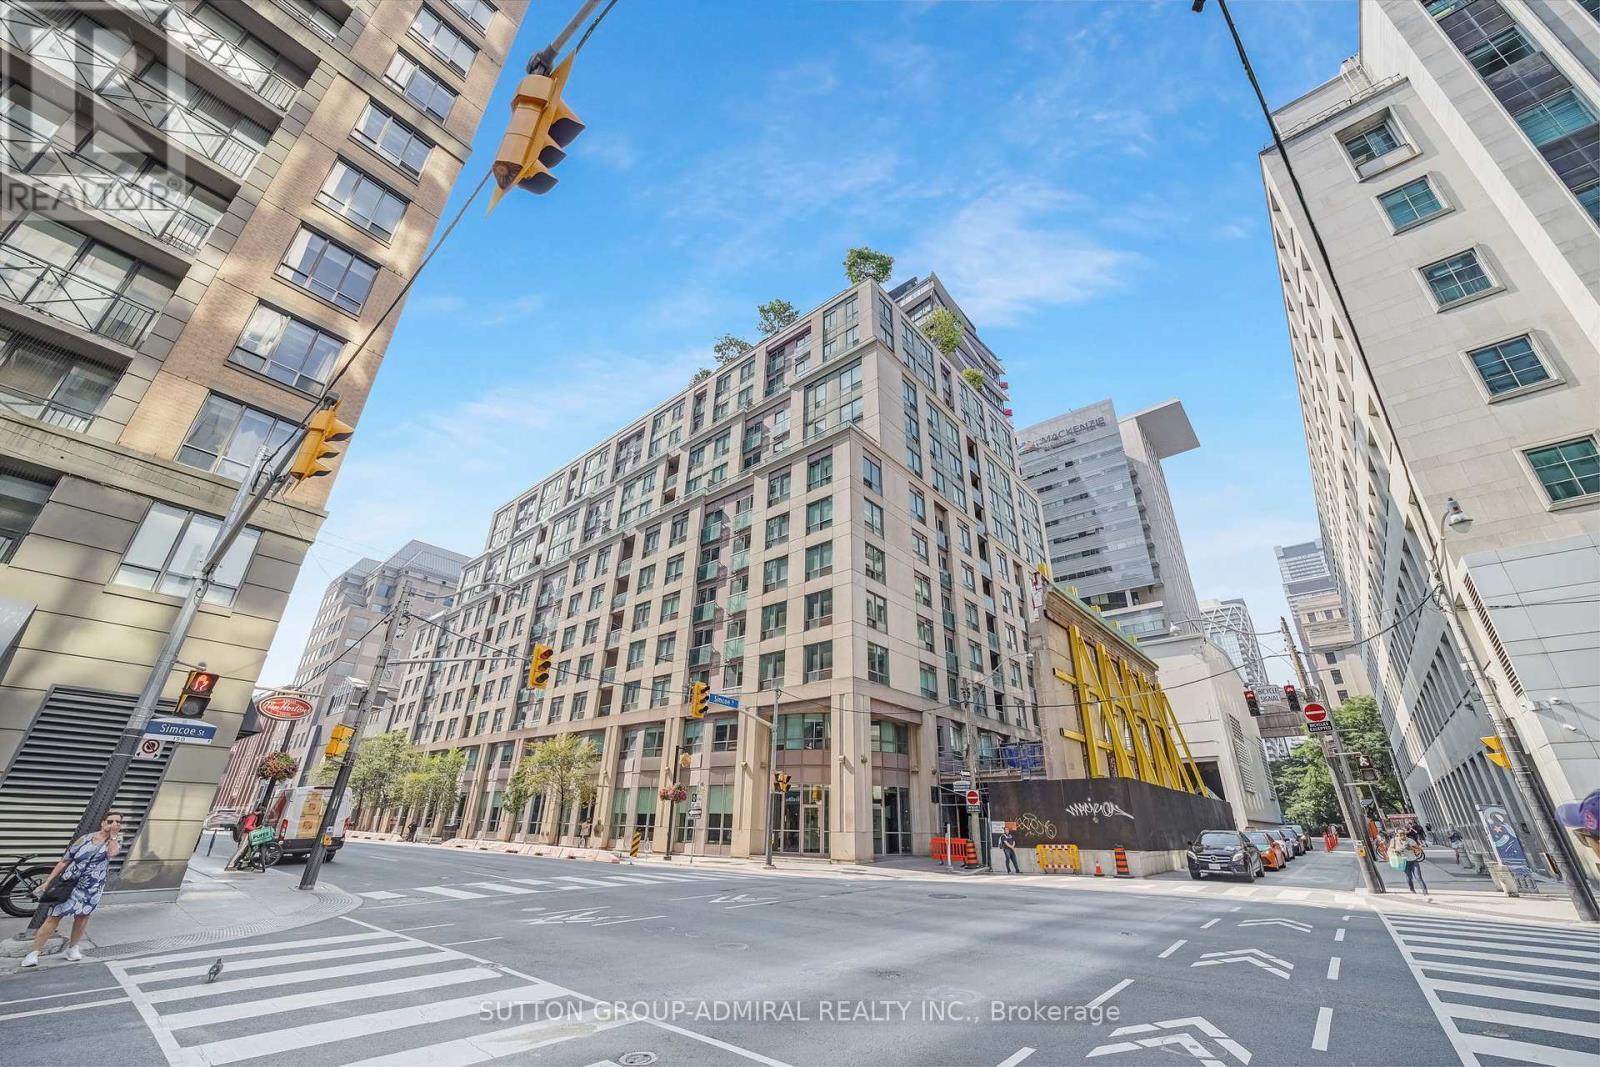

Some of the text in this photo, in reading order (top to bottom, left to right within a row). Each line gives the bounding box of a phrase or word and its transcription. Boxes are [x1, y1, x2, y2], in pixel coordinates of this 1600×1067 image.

[1041, 416, 1106, 442] MACKENZIE
[160, 723, 205, 737] Simcoe St
